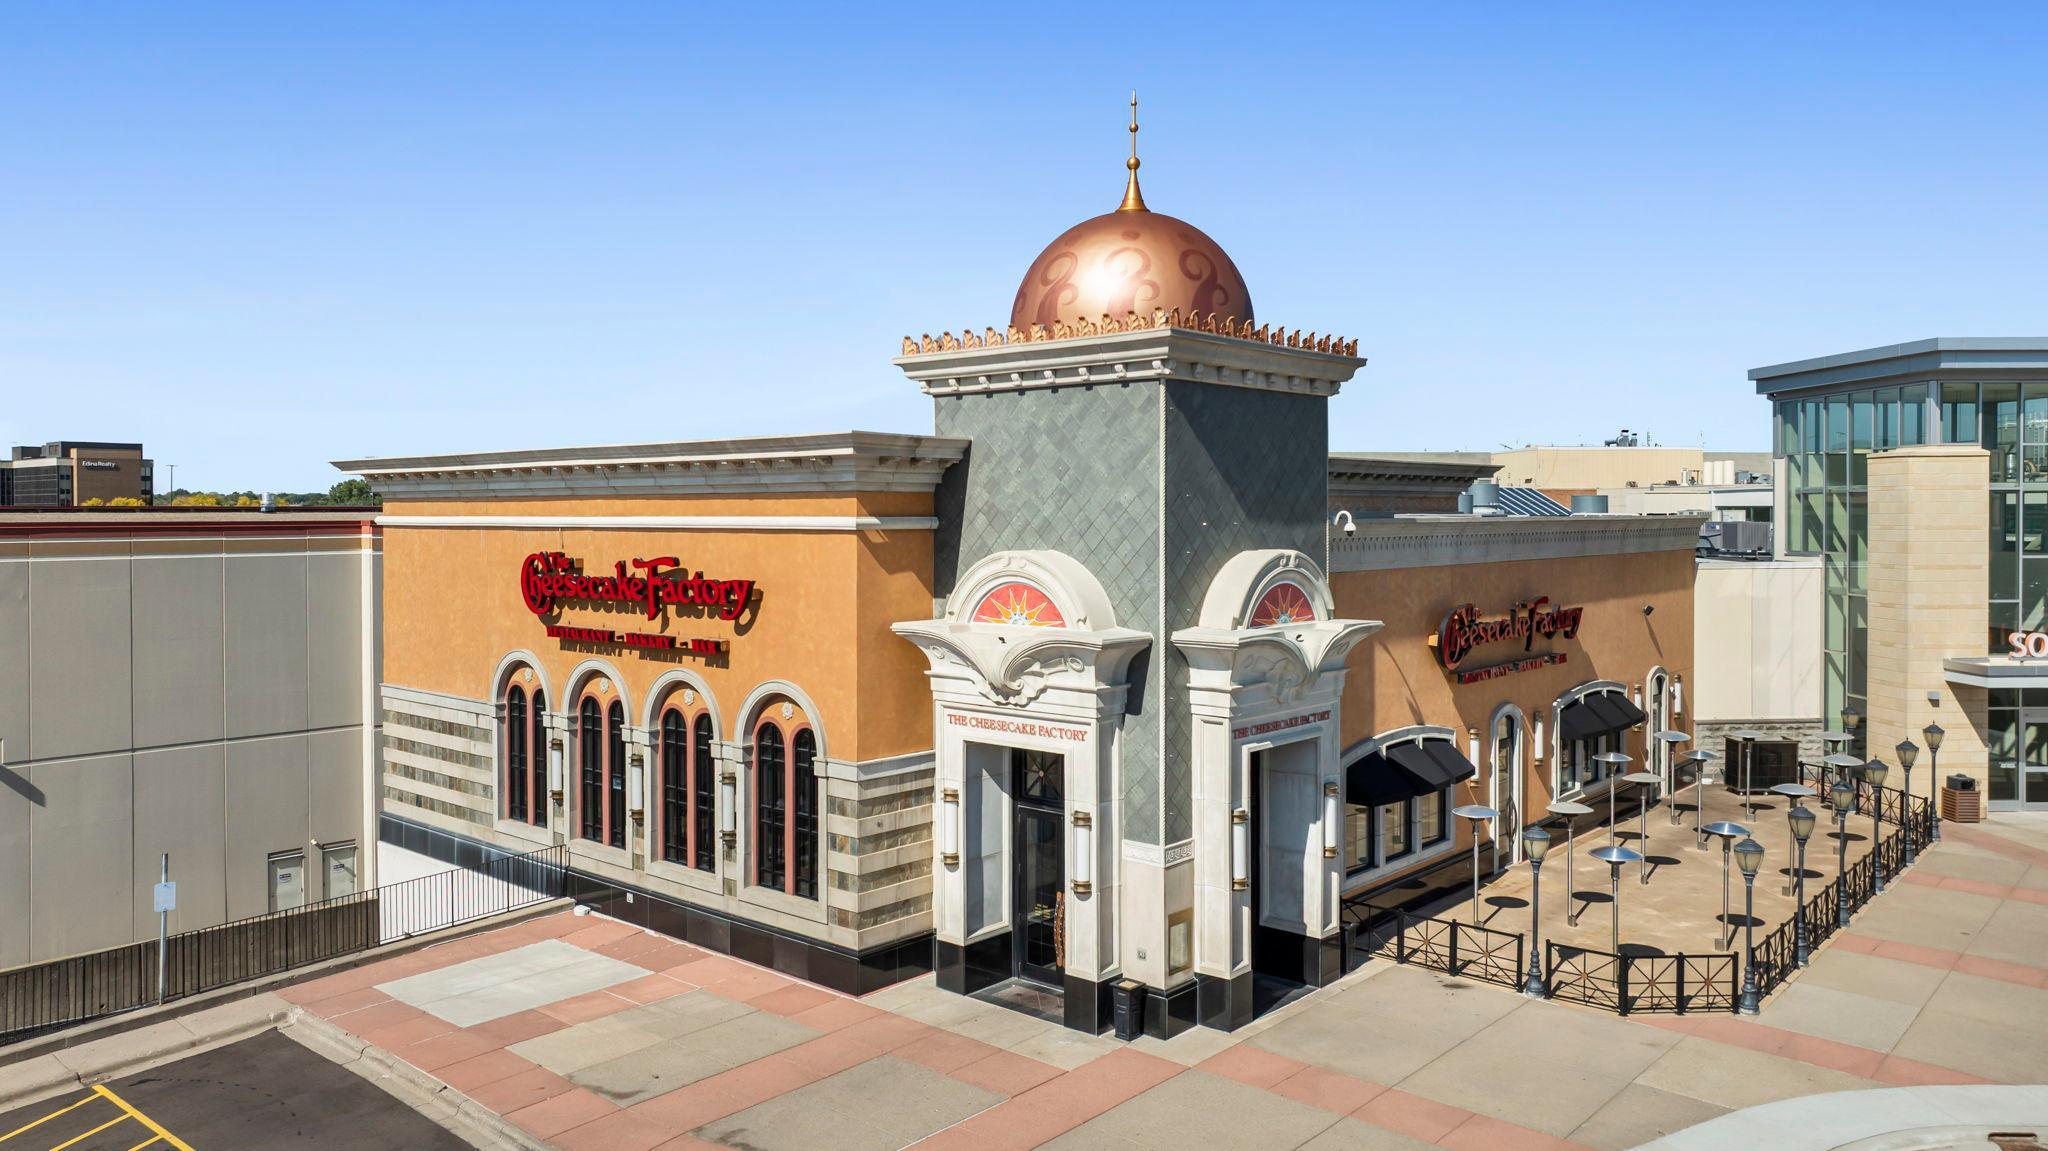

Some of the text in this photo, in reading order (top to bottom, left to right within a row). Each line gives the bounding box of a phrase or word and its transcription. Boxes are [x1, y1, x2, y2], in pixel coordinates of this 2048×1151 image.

[548, 552, 574, 570] The
[521, 553, 757, 621] Cheesecake Factory
[1458, 603, 1482, 623] The
[546, 625, 611, 643] RESTAURANT
[625, 633, 671, 650] BAKERY
[1443, 596, 1584, 670] Cheesecake Factory
[2008, 632, 2048, 657] SO
[947, 714, 1088, 742] THE CHEESECAKE FACTORY
[1232, 710, 1332, 739] THE CHEESECAKE FACTORY
